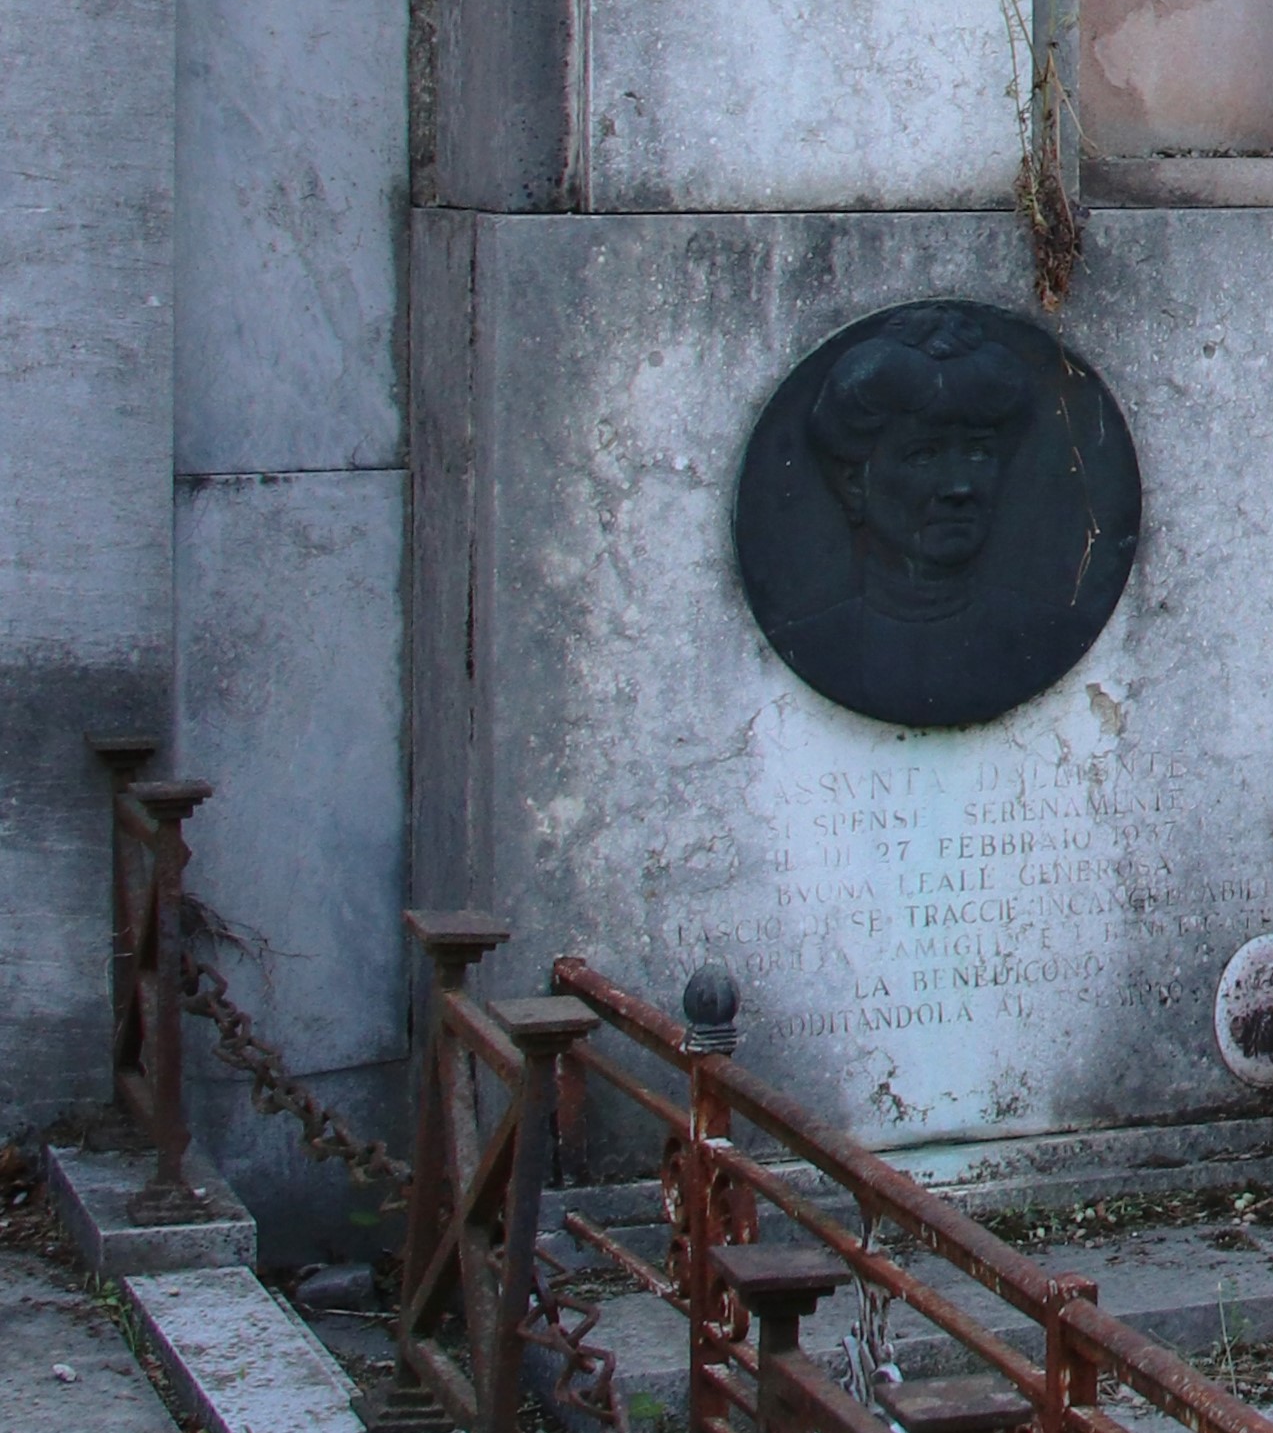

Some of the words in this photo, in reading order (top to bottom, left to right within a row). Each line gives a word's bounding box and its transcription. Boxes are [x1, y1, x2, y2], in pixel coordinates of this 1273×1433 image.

[875, 839, 913, 865] 27
[938, 826, 1092, 861] FEBBRAIO
[854, 975, 891, 1001] LA
[913, 954, 1104, 994] BENEDICONO
